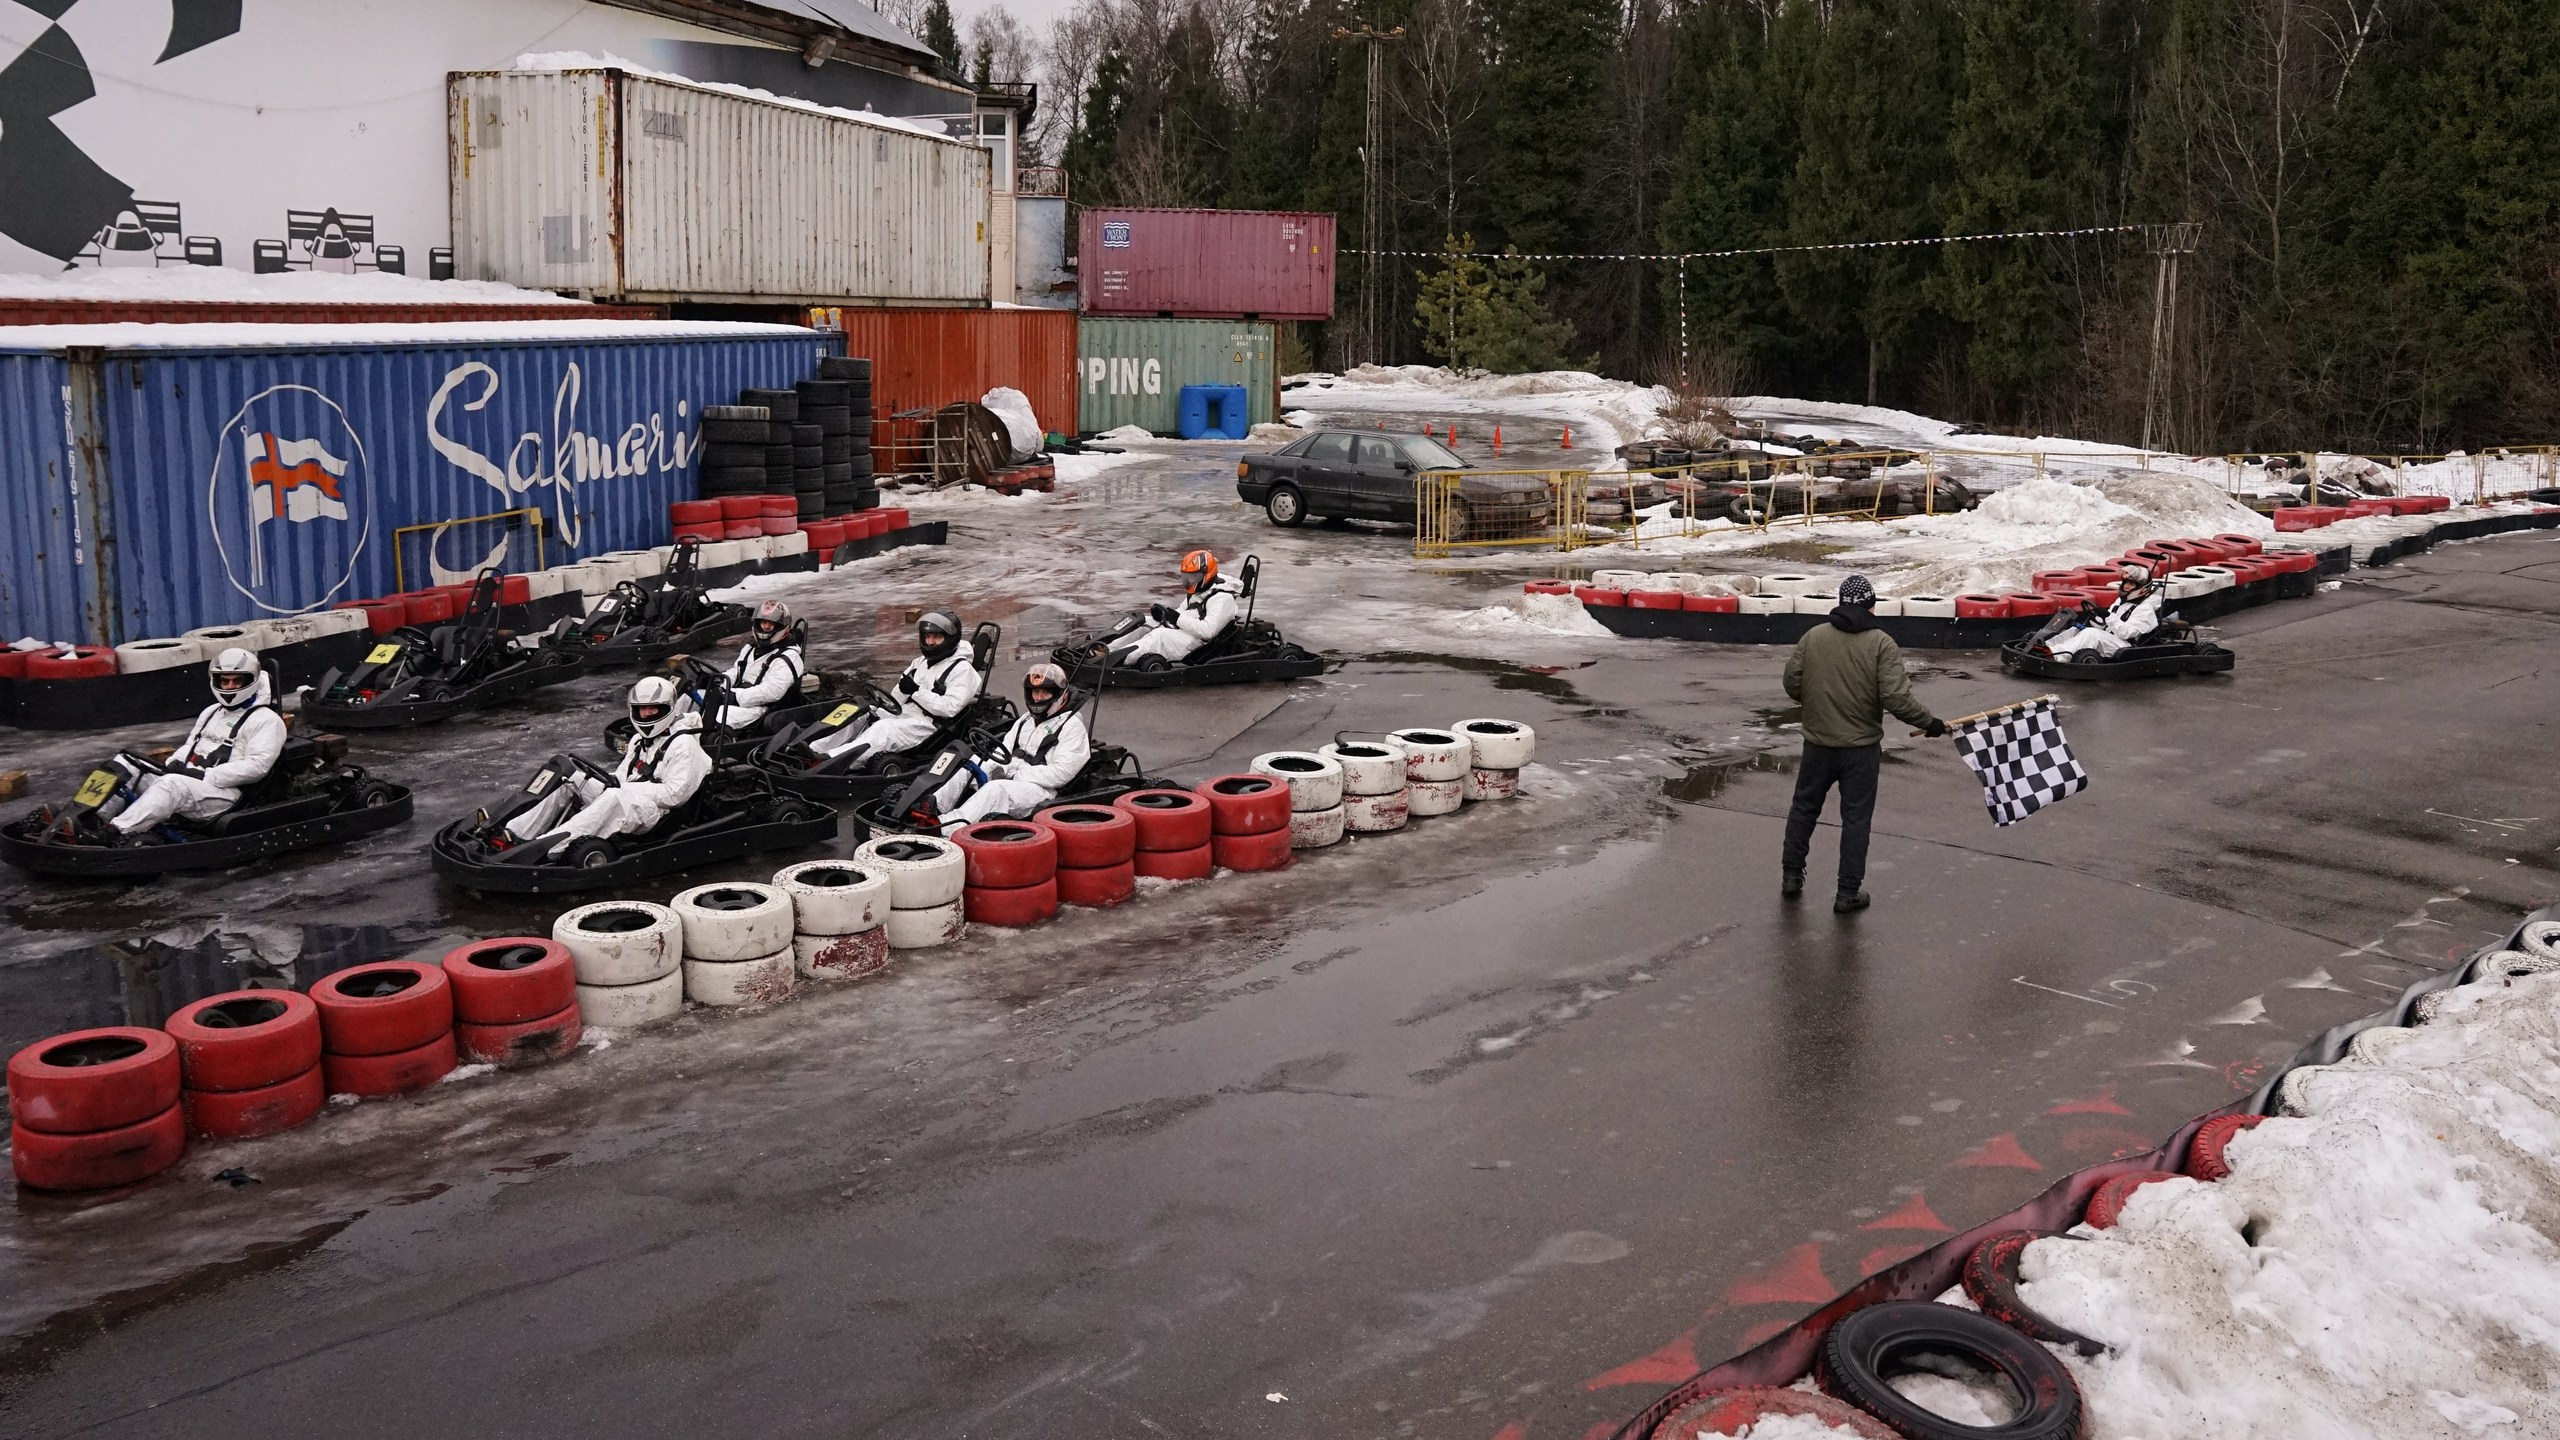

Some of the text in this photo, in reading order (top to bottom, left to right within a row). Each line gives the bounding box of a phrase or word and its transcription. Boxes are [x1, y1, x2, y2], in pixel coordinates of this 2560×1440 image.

[61, 385, 75, 446] MSKU
[375, 649, 388, 659] 4
[832, 709, 847, 719] 6
[936, 757, 948, 770] 3
[84, 779, 106, 797] 14
[535, 775, 547, 789] 1
